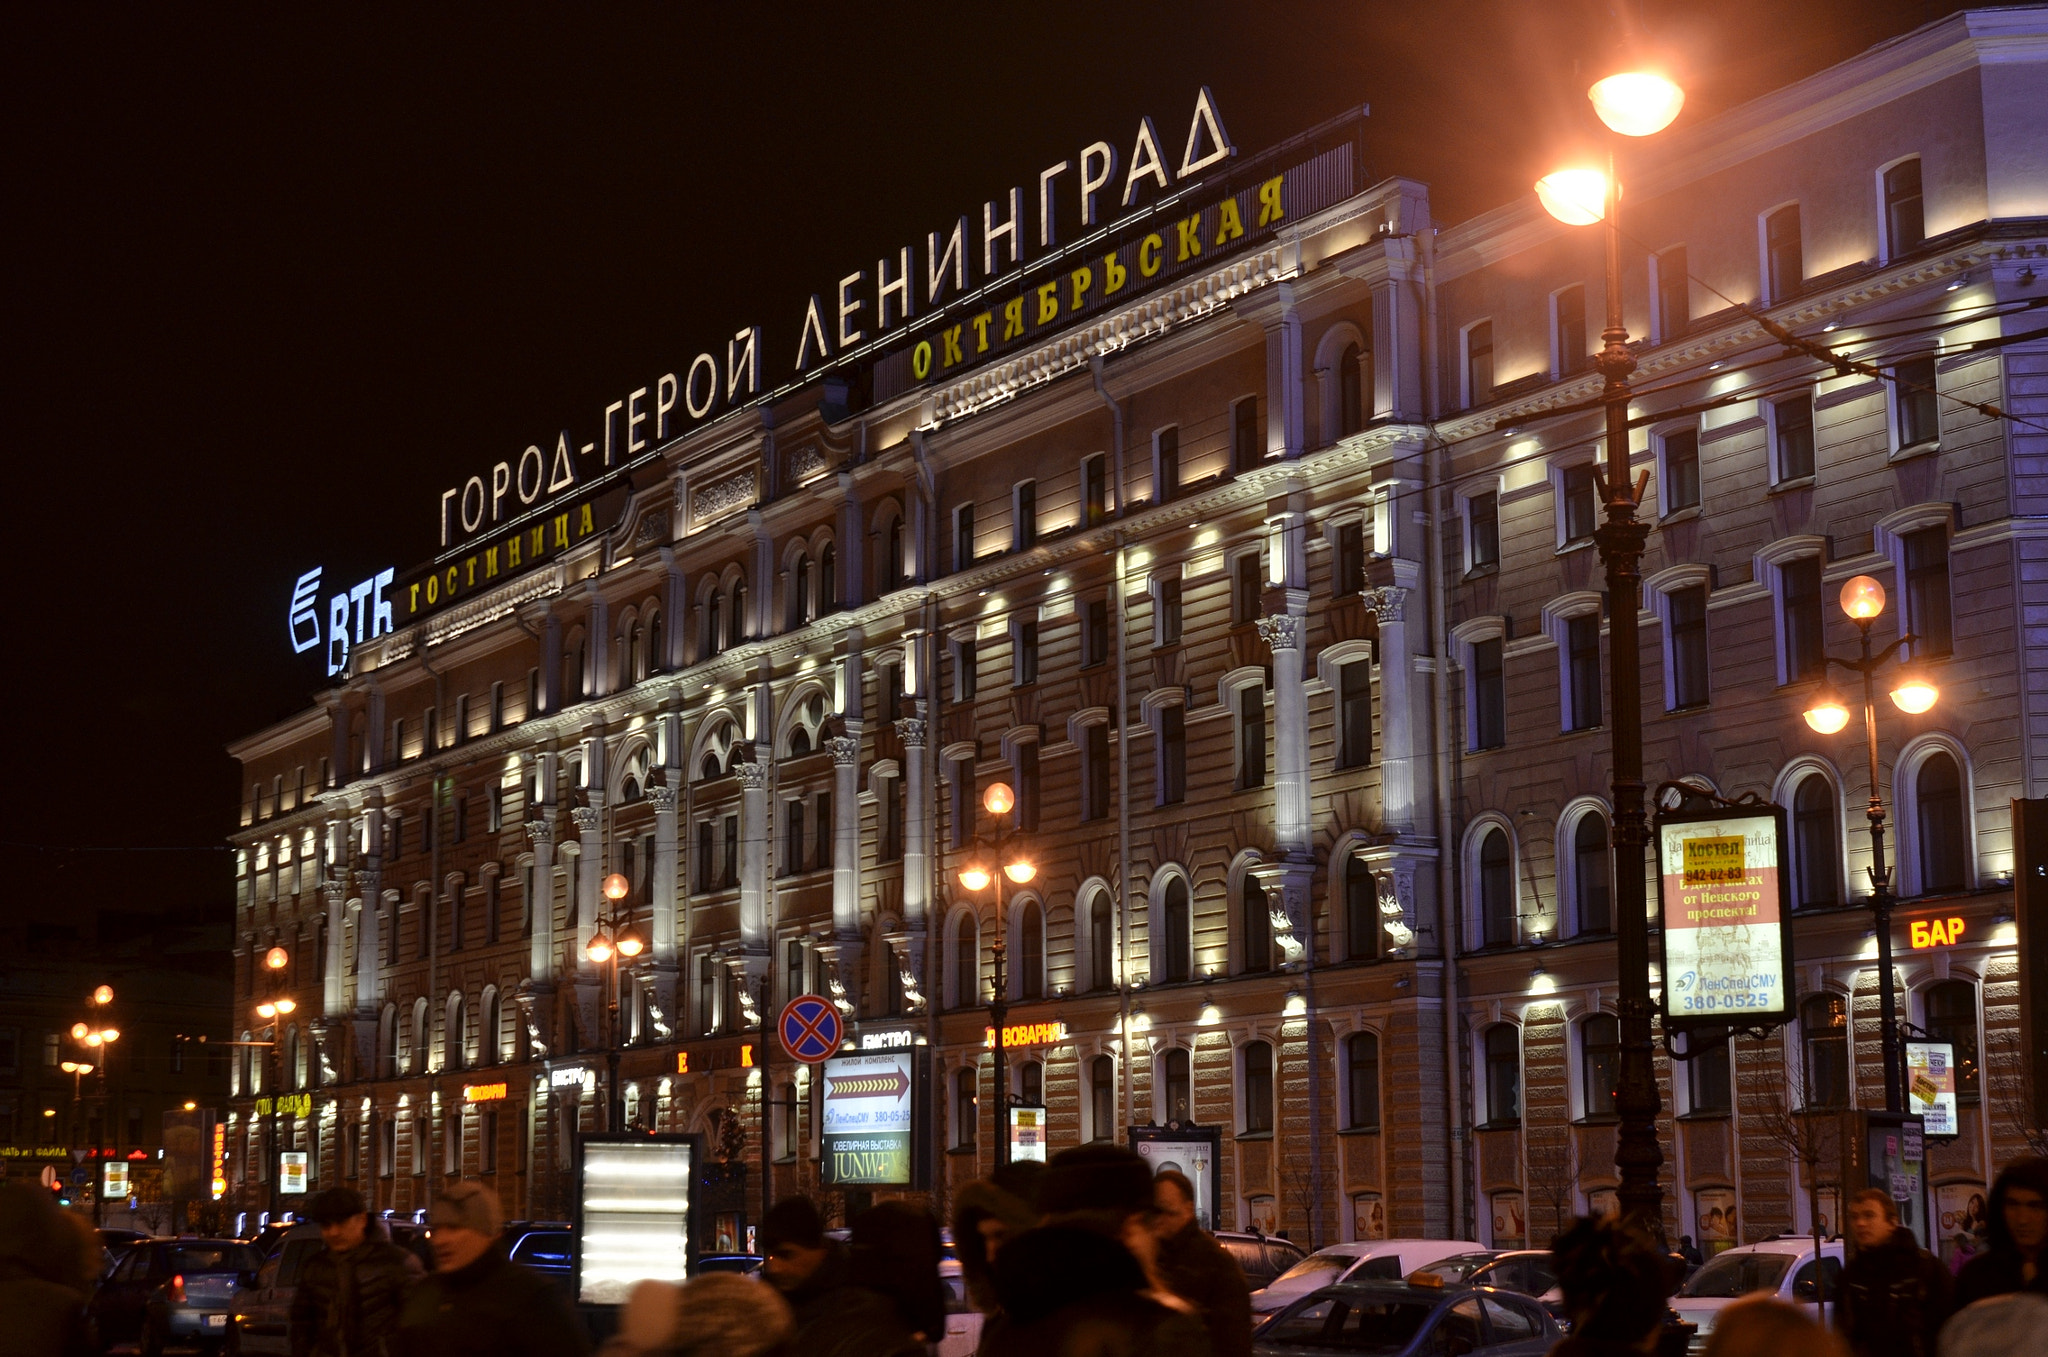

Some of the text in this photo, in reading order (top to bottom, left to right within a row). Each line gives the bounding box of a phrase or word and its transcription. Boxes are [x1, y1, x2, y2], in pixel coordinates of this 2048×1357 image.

[912, 174, 1286, 380] ОКТЯБРЬСКАЯ
[441, 85, 1235, 547] ГОРОД-ГЕРОЙ ЛЕНИНГРАД
[410, 502, 595, 612] ГОСТИНИЦА
[327, 567, 395, 676] ВТБ
[1688, 841, 1739, 857] Хостел
[1686, 867, 1741, 882] 942-02-83
[1683, 891, 1760, 905] от Невского
[1687, 904, 1758, 922] проспекта!
[1911, 917, 1965, 949] БАР
[1699, 973, 1777, 991] ЛенСпецСМУ
[1684, 993, 1768, 1010] 380-0525
[986, 1023, 1061, 1049] ПВОВАРНЯ
[875, 1110, 910, 1122] 380-05-25
[36, 1146, 67, 1157] ФАЙЛА
[833, 1138, 902, 1152] ЮВЕЛИРНАЯ ВЫСТАВКА
